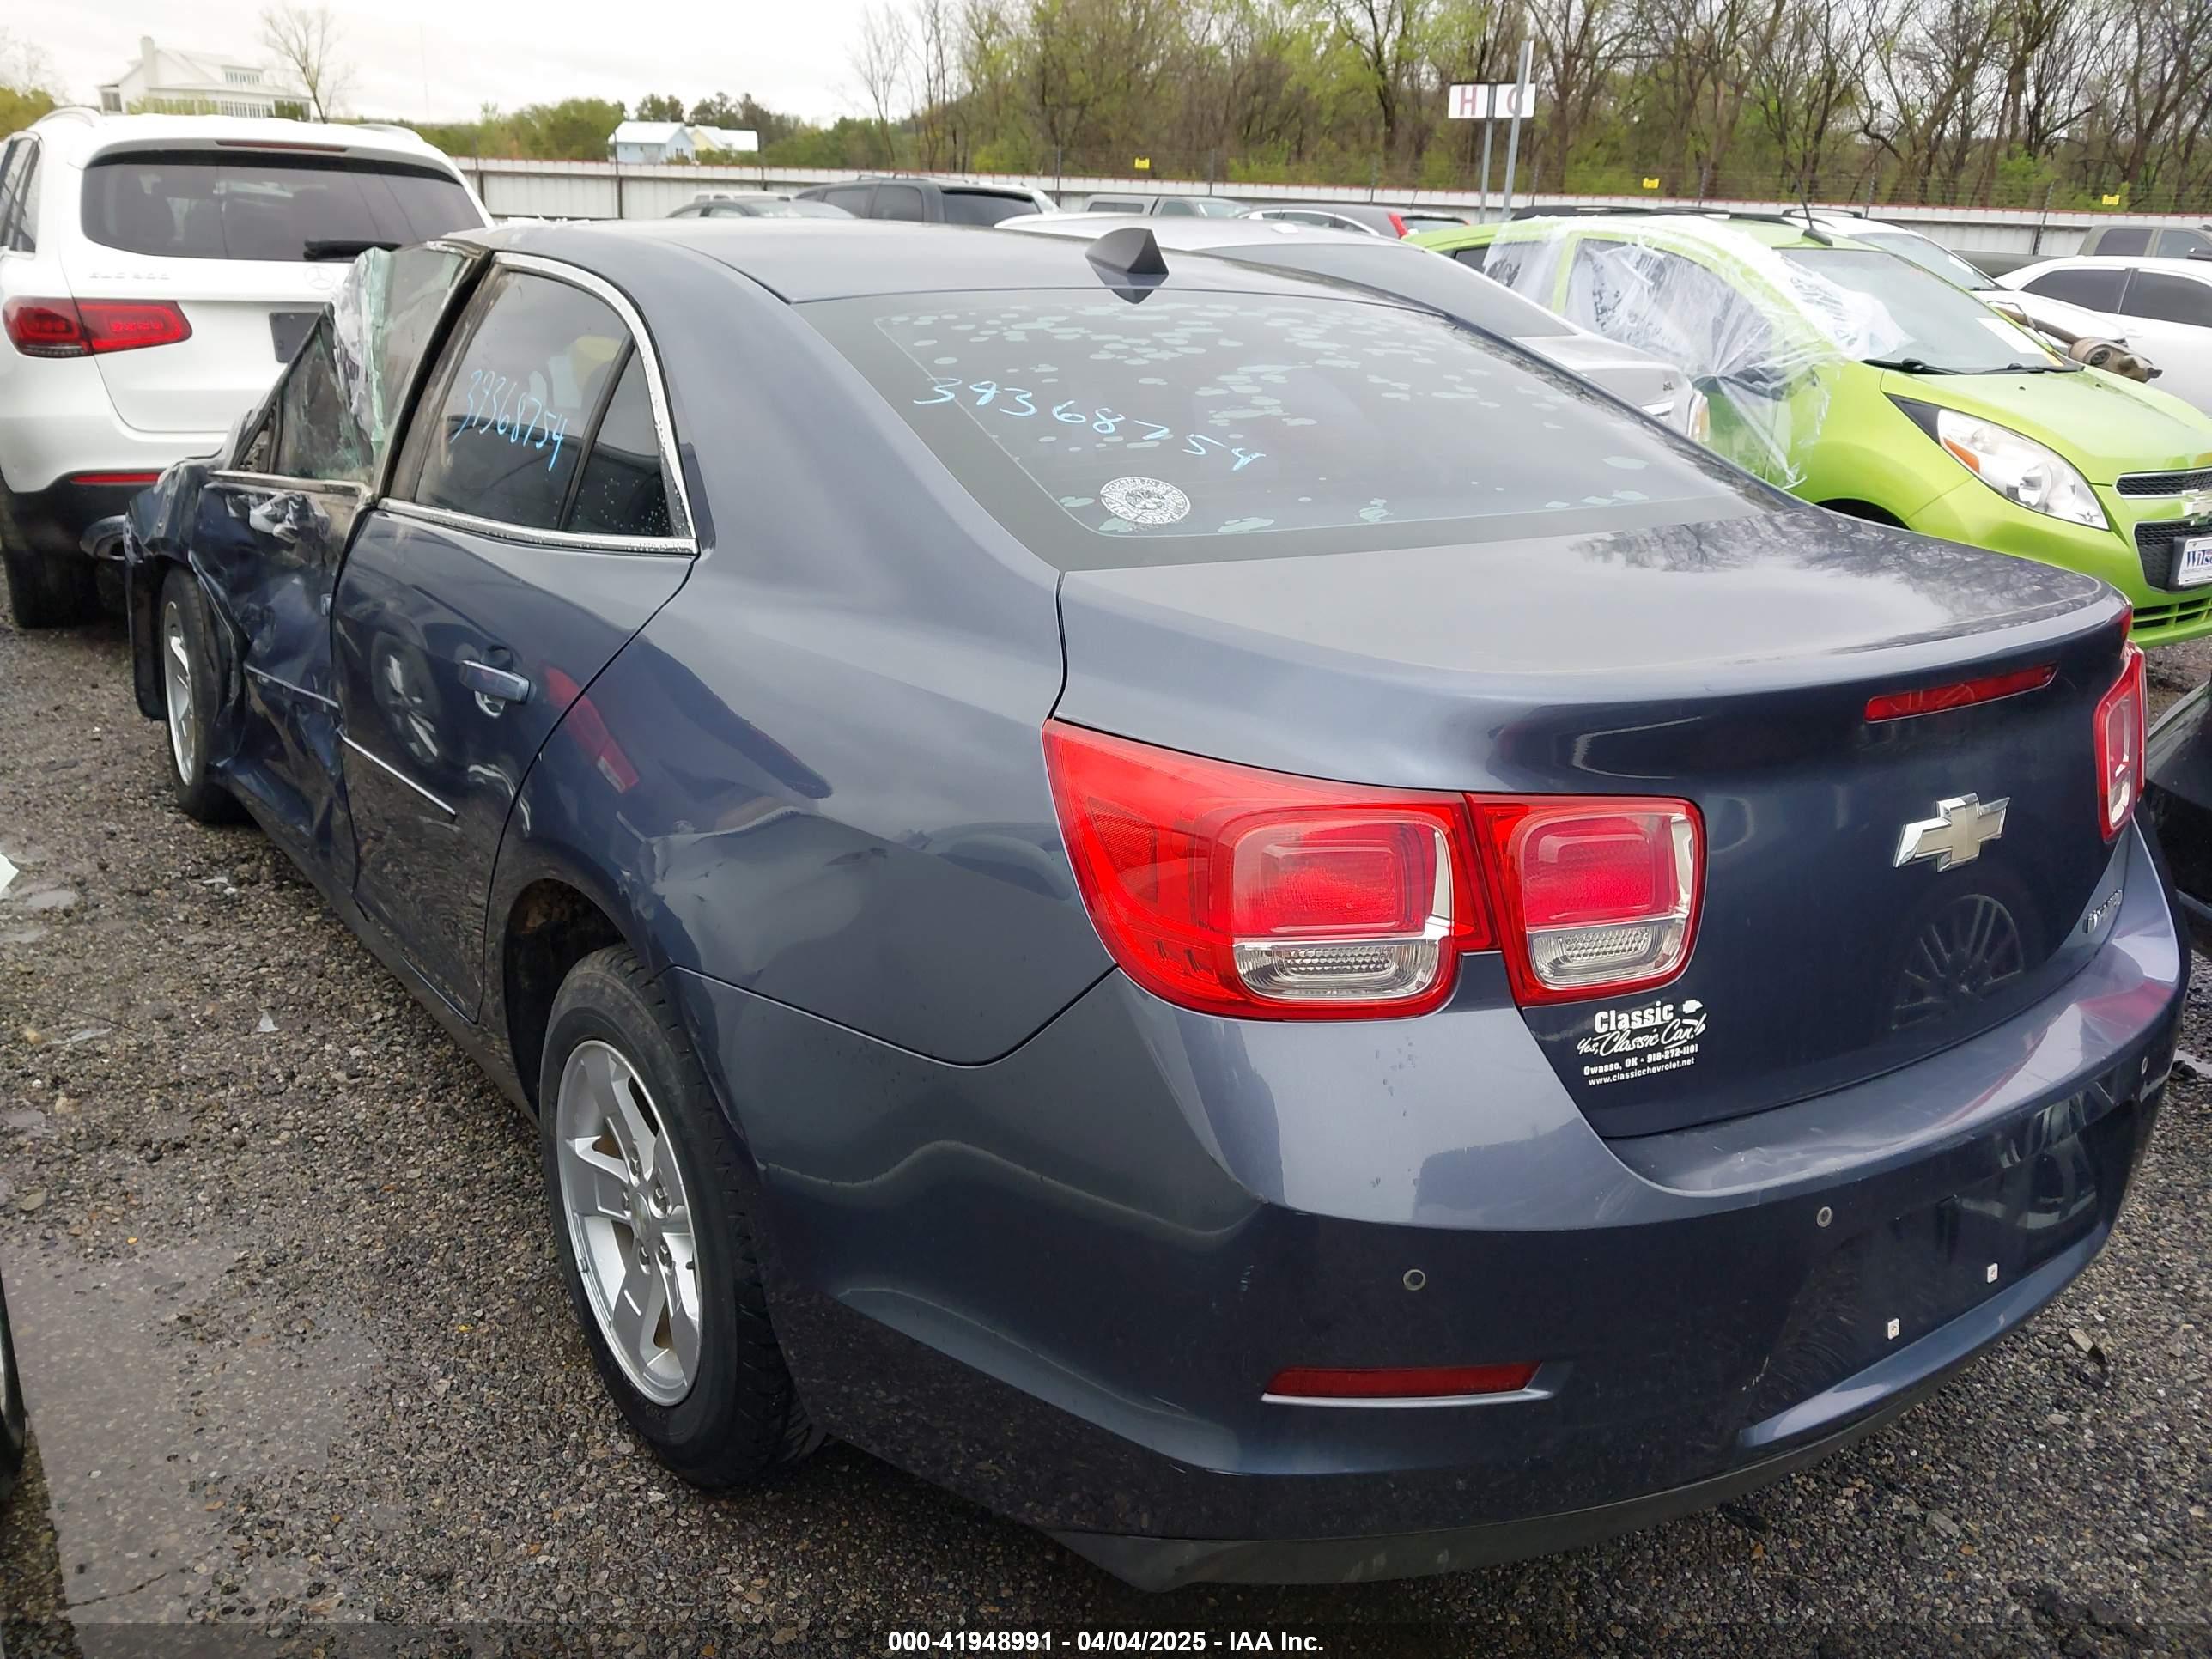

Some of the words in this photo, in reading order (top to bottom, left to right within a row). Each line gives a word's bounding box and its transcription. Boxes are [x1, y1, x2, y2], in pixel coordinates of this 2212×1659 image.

[1460, 86, 1477, 116] H
[449, 369, 568, 471] 39368754
[1595, 1000, 1674, 1033] Classic
[1577, 1037, 1599, 1055] Yes,
[1599, 1029, 1659, 1057] Classic
[1583, 1061, 1622, 1076] Owasso,
[1625, 1056, 1638, 1068] OK
[1646, 1044, 1698, 1063] 918-272-1101
[1589, 1056, 1695, 1086] www.classicchevrolet.net
